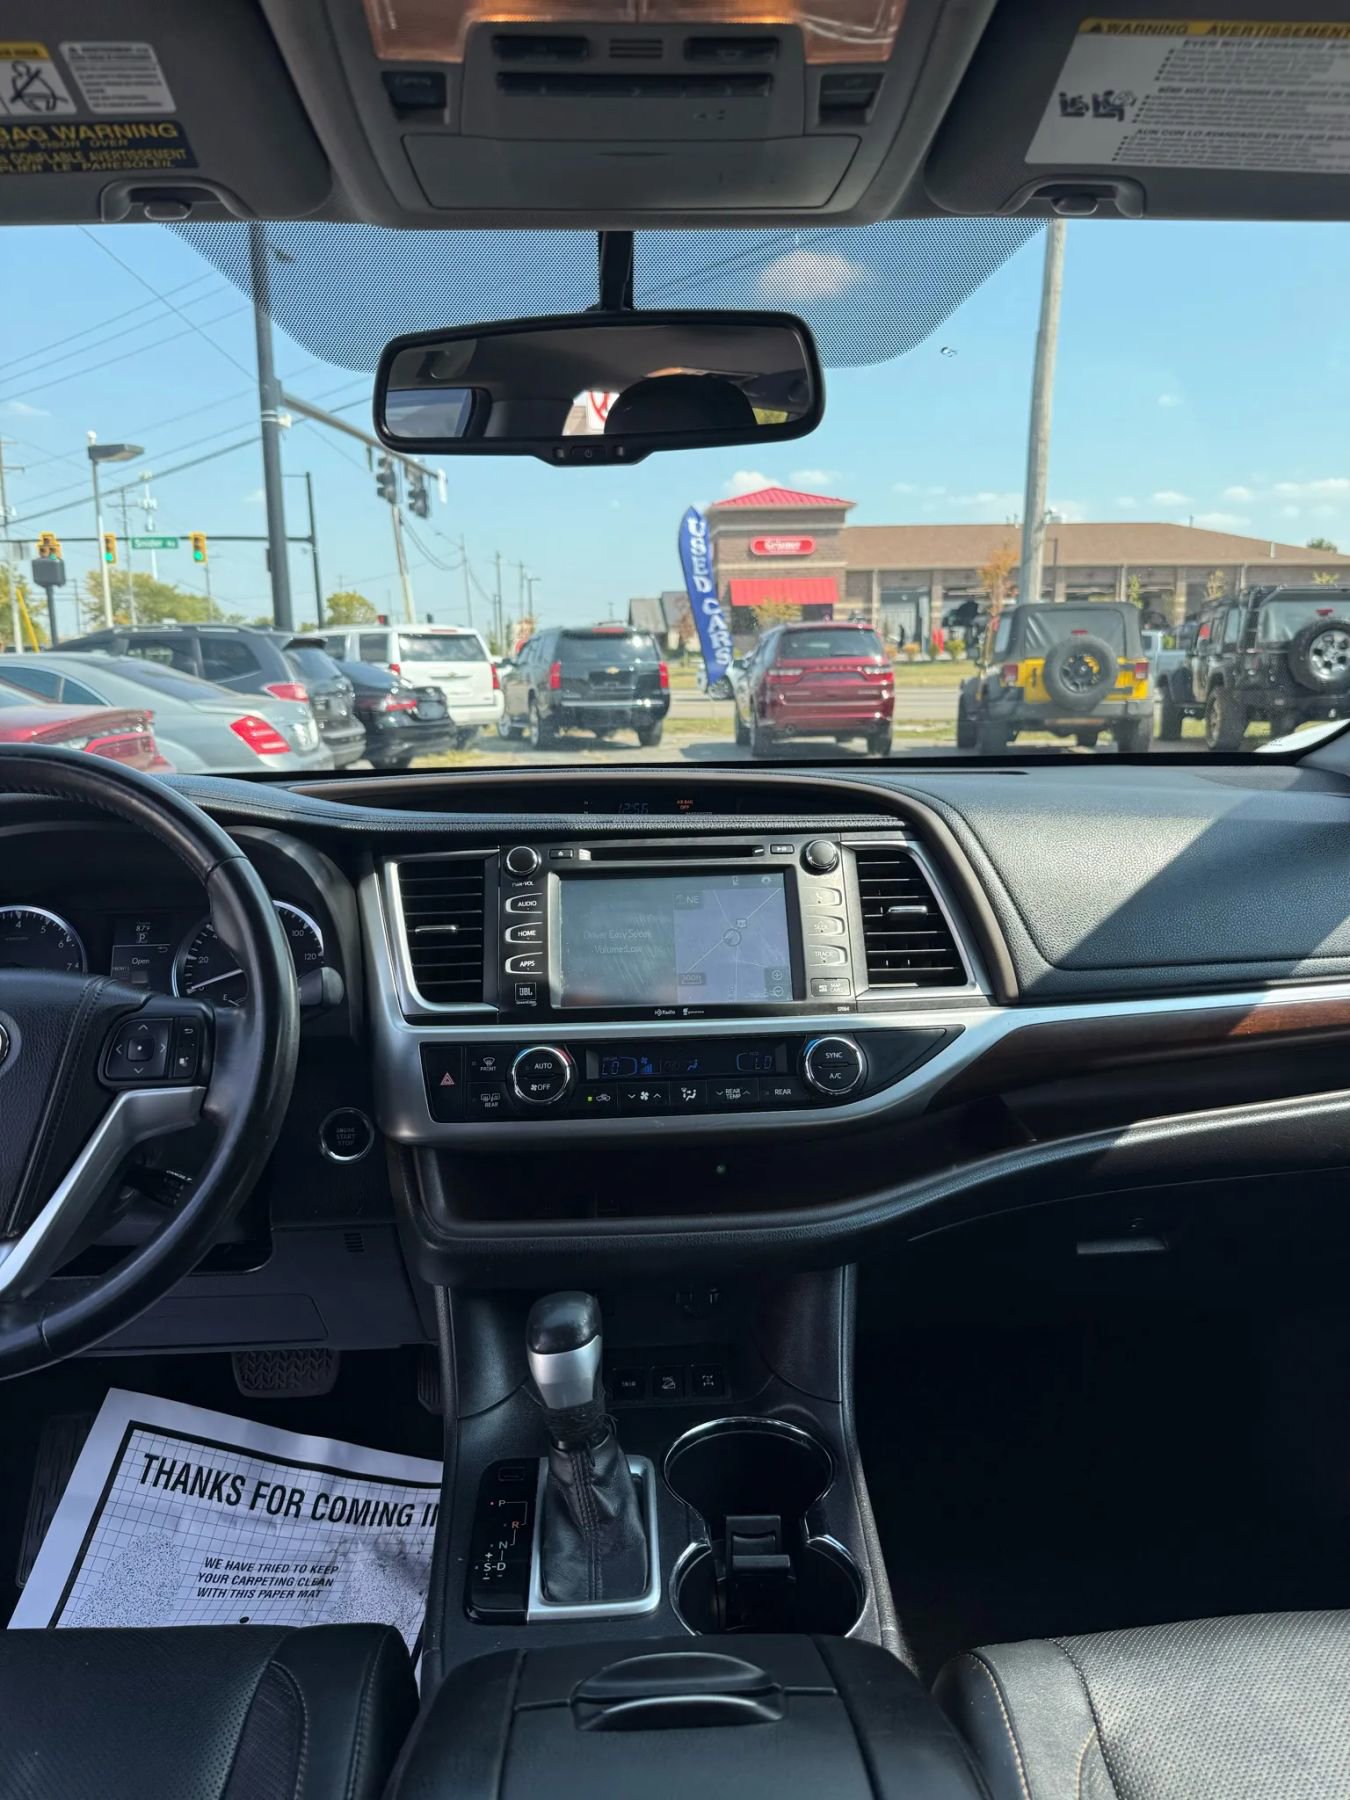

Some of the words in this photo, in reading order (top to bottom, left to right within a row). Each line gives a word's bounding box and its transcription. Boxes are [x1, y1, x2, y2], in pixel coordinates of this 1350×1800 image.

[1105, 22, 1188, 35] WARNING
[1206, 23, 1350, 39] AVERTISSEMENT
[51, 121, 179, 141] WARNING
[90, 137, 128, 148] OVER
[90, 148, 187, 164] AVERTISSEMENT
[687, 517, 713, 594] USED
[702, 597, 733, 666] CARS
[518, 900, 538, 908] AUDIO
[687, 896, 700, 904] NE
[16, 920, 22, 929] 4
[40, 925, 46, 934] 5
[292, 929, 305, 937] 100
[58, 940, 65, 949] 6
[199, 956, 210, 964] 20
[304, 952, 317, 961] 120
[131, 957, 150, 966] Open
[519, 960, 536, 968] APPS
[519, 987, 533, 997] JBL
[825, 1052, 843, 1060] SYNC
[534, 1062, 553, 1070] AUTO
[537, 1083, 552, 1091] OFF
[774, 1088, 792, 1096] REAR
[140, 1453, 247, 1506] THANKS
[249, 1480, 306, 1519] FOR
[311, 1493, 415, 1528] COMING
[511, 1520, 520, 1529] R
[498, 1541, 508, 1550] N
[204, 1556, 223, 1570] WE
[224, 1560, 255, 1573] HAVE
[257, 1563, 290, 1574] TRIED
[293, 1564, 308, 1574] TO
[310, 1564, 340, 1575] KEEP
[198, 1572, 229, 1585] YOUR
[231, 1574, 295, 1587] CARPETING
[297, 1577, 335, 1588] CLEAN
[197, 1586, 228, 1599] WITH
[229, 1588, 256, 1599] THIS
[256, 1589, 295, 1599] PAPER
[296, 1589, 324, 1599] MAT
